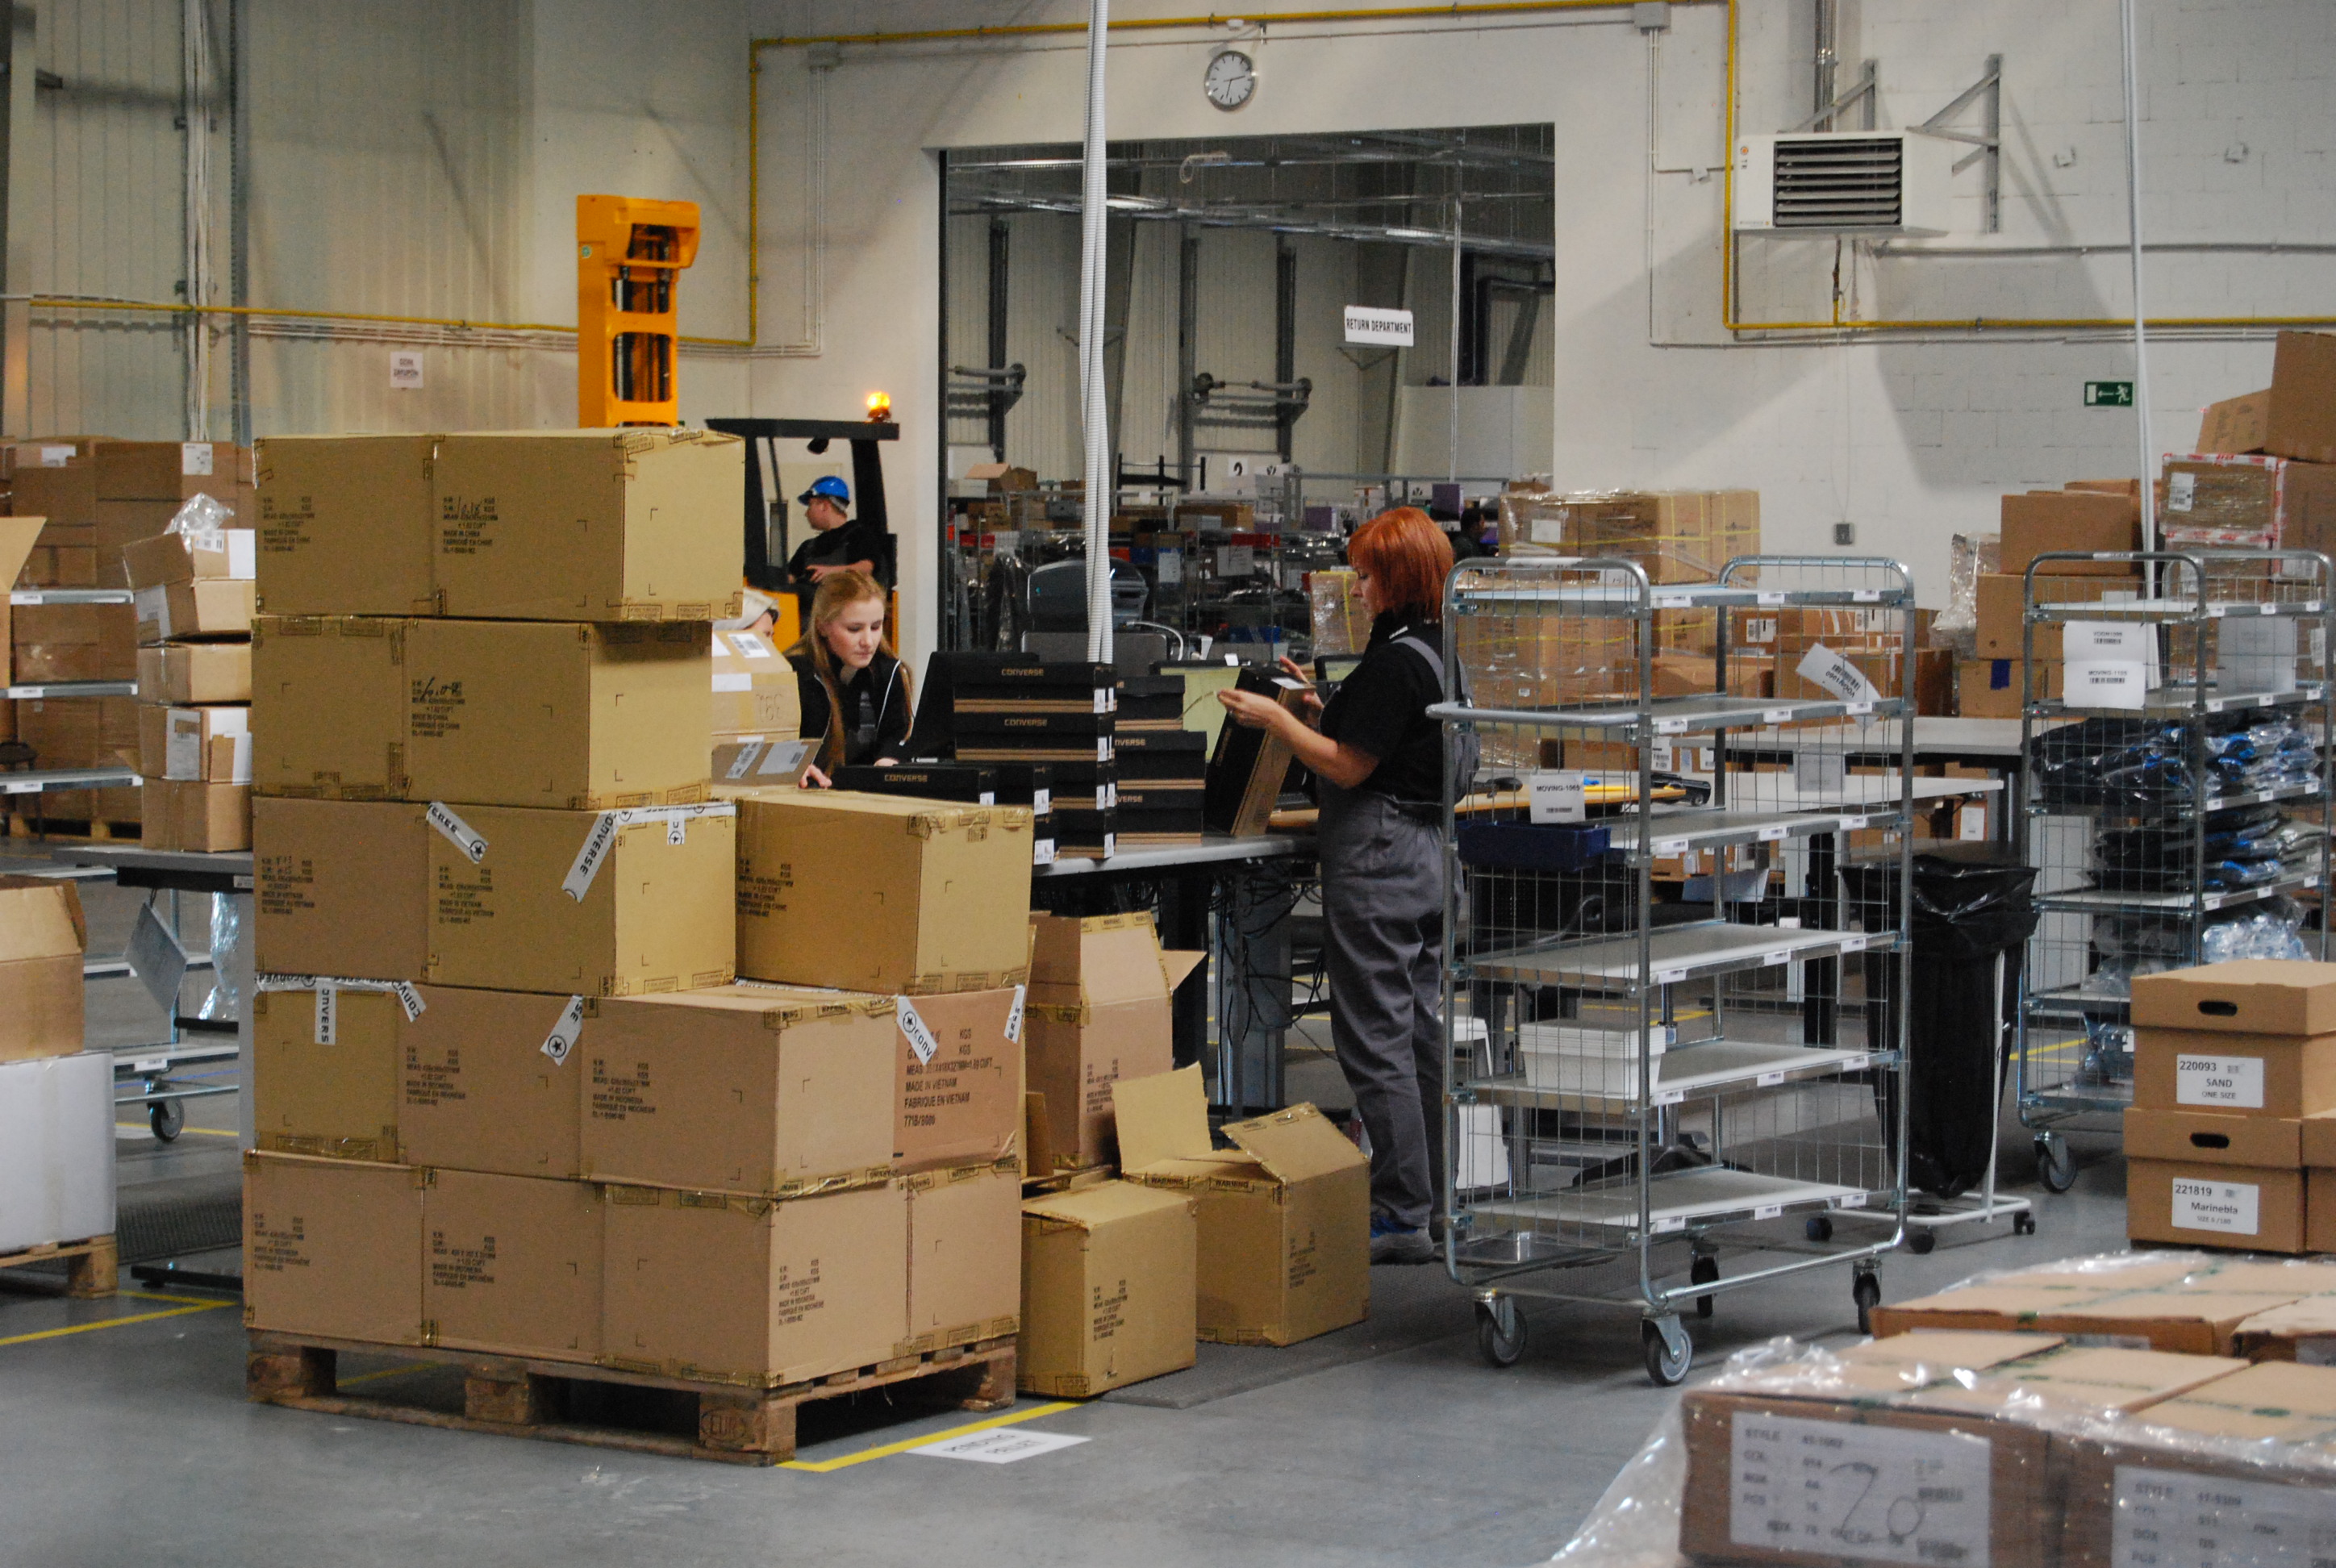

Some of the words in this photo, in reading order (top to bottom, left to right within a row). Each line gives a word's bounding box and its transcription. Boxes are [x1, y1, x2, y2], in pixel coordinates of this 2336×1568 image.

[1346, 318, 1370, 331] RETURN
[1371, 320, 1412, 334] DEPARTMENT
[1001, 668, 1044, 676] CONVERSE
[1004, 719, 1047, 727] CONVERSE
[884, 774, 928, 782] CONVERSE
[579, 812, 618, 876] CONVERSE
[959, 1028, 971, 1040] KGS
[959, 1045, 971, 1055] KGS
[2180, 1061, 2217, 1072] 220093
[906, 1081, 924, 1092] MADE
[925, 1080, 931, 1090] IN
[932, 1078, 957, 1090] VIETNAM
[2206, 1078, 2233, 1088] SAND
[904, 1095, 936, 1109] FABRIQUE
[937, 1095, 945, 1105] EN
[945, 1092, 970, 1104] VIETNAM
[2220, 1091, 2236, 1099] SIZE
[1151, 1177, 1185, 1186] WARNING
[1215, 1179, 1249, 1189] WARNING
[2175, 1184, 2212, 1196] 221819
[2191, 1202, 2238, 1215] Marinebla
